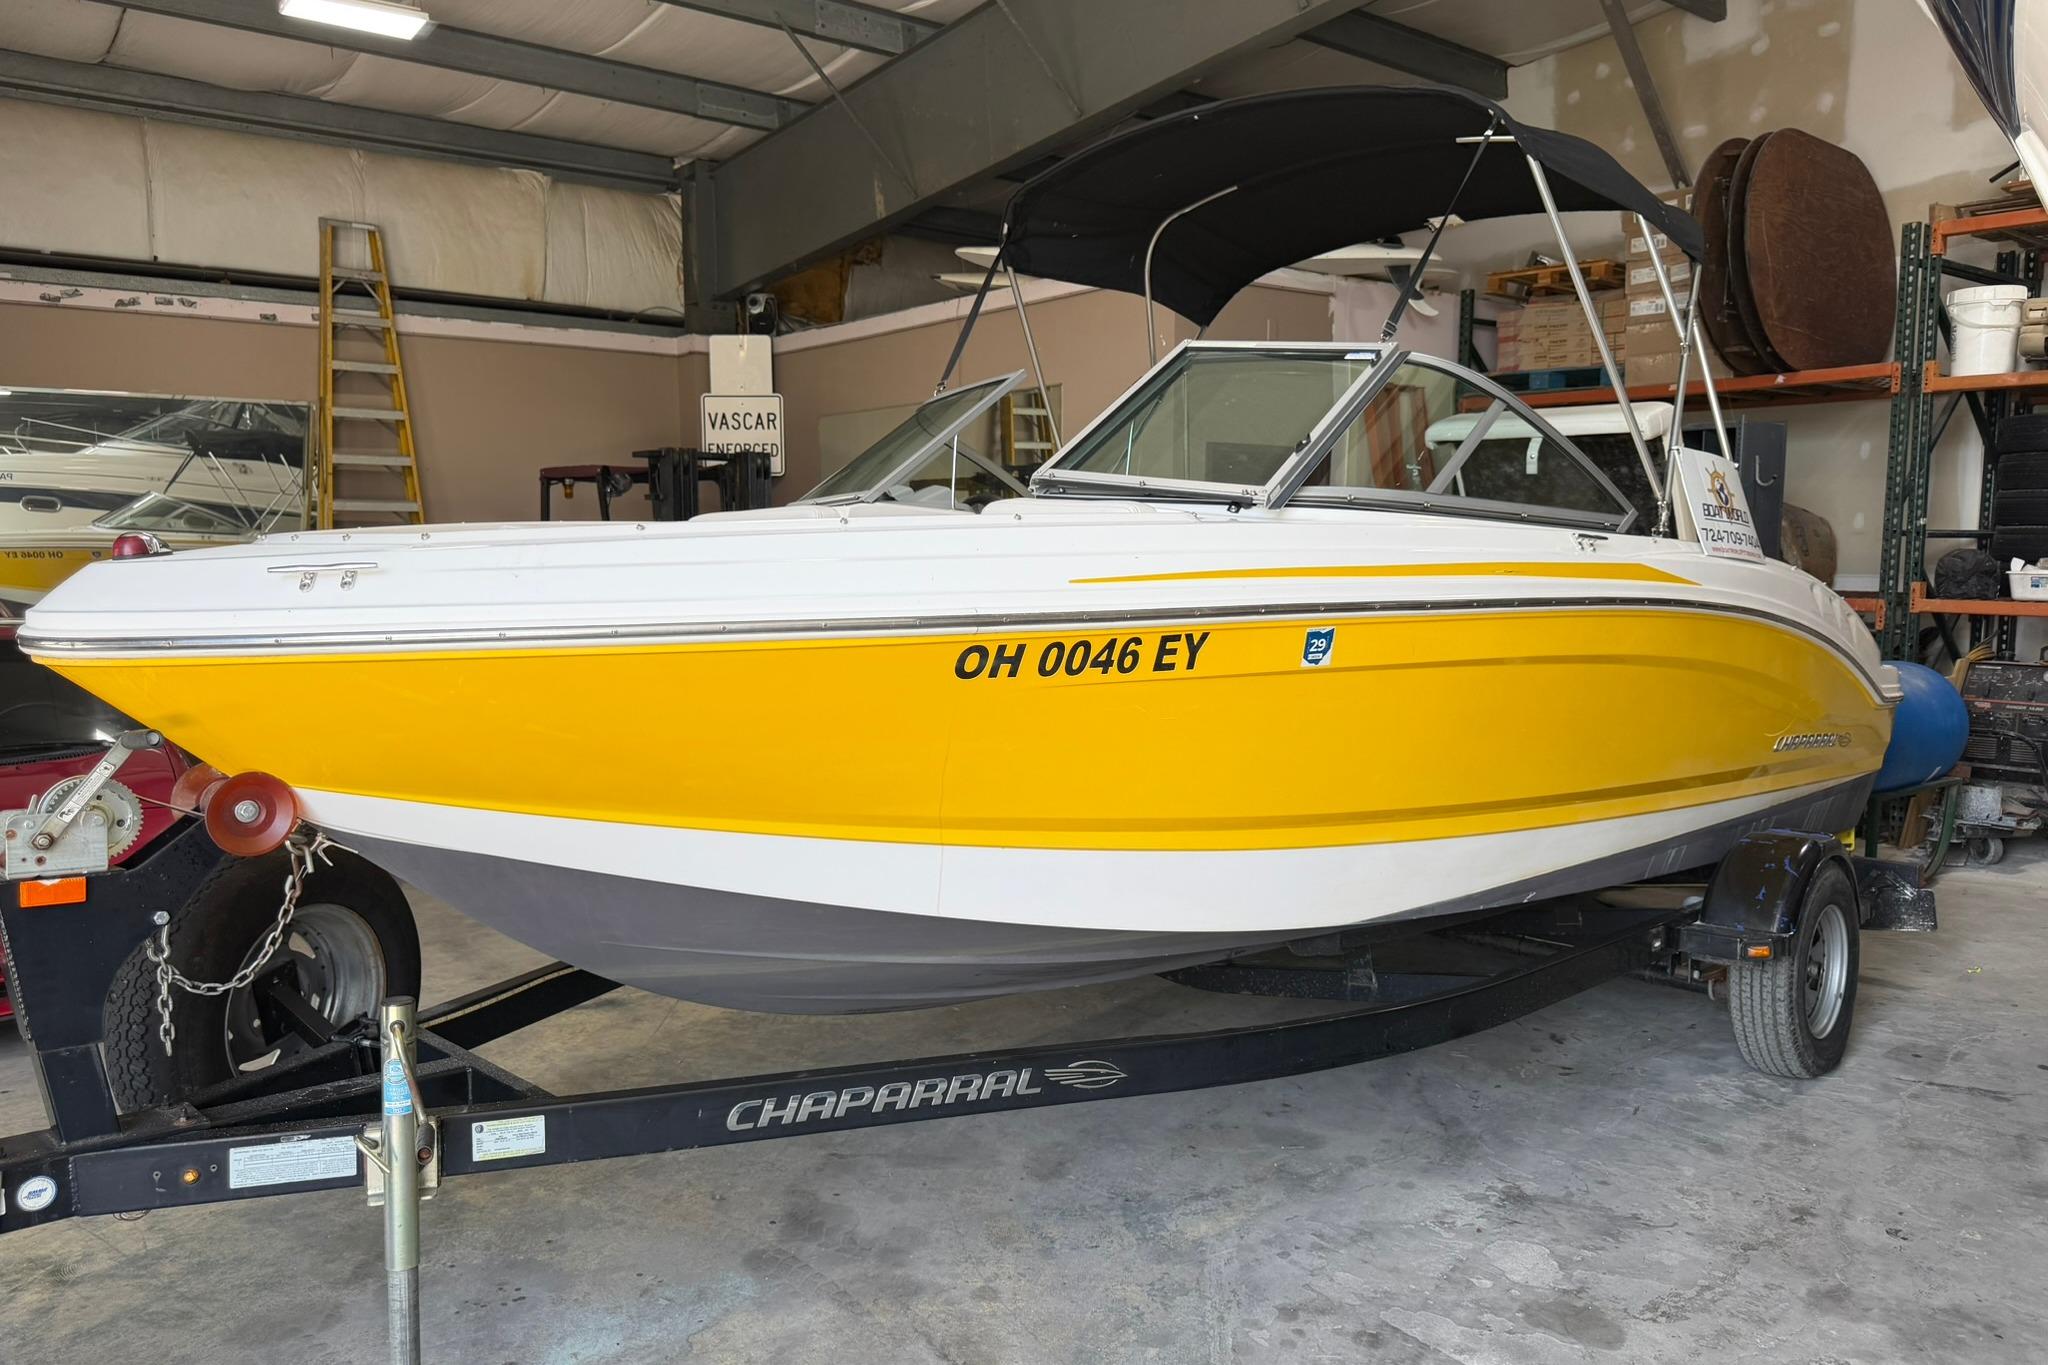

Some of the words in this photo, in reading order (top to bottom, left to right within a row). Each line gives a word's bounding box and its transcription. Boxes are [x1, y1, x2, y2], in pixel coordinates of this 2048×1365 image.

[707, 412, 777, 430] VASCAR
[954, 643, 1027, 680] OH
[1037, 636, 1142, 677] 0046
[1152, 632, 1210, 672] EY
[1309, 639, 1326, 652] 29
[726, 1067, 1042, 1131] CHAPARRAL
